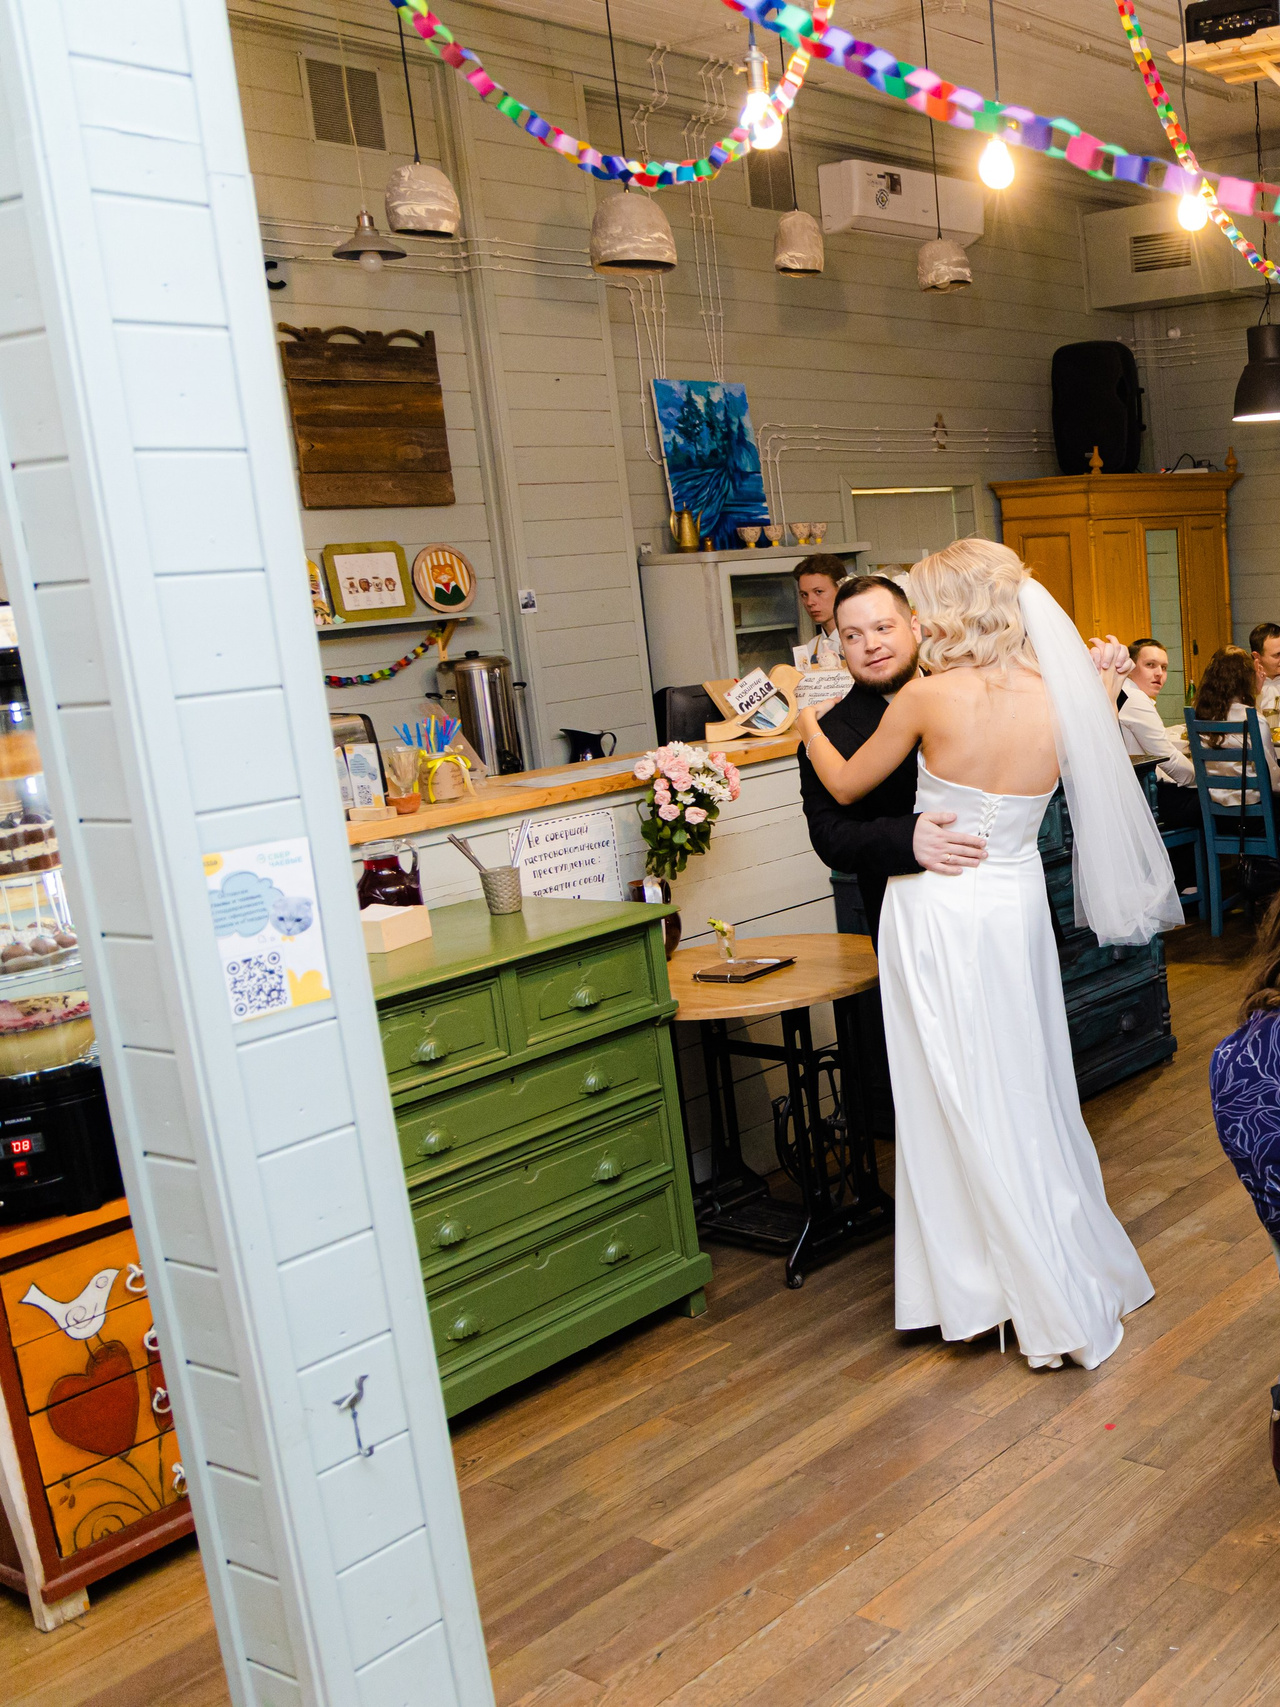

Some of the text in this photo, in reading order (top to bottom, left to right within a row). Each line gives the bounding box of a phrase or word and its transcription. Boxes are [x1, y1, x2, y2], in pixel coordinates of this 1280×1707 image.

[526, 823, 588, 849] Не совершай
[532, 855, 601, 879] преступление:
